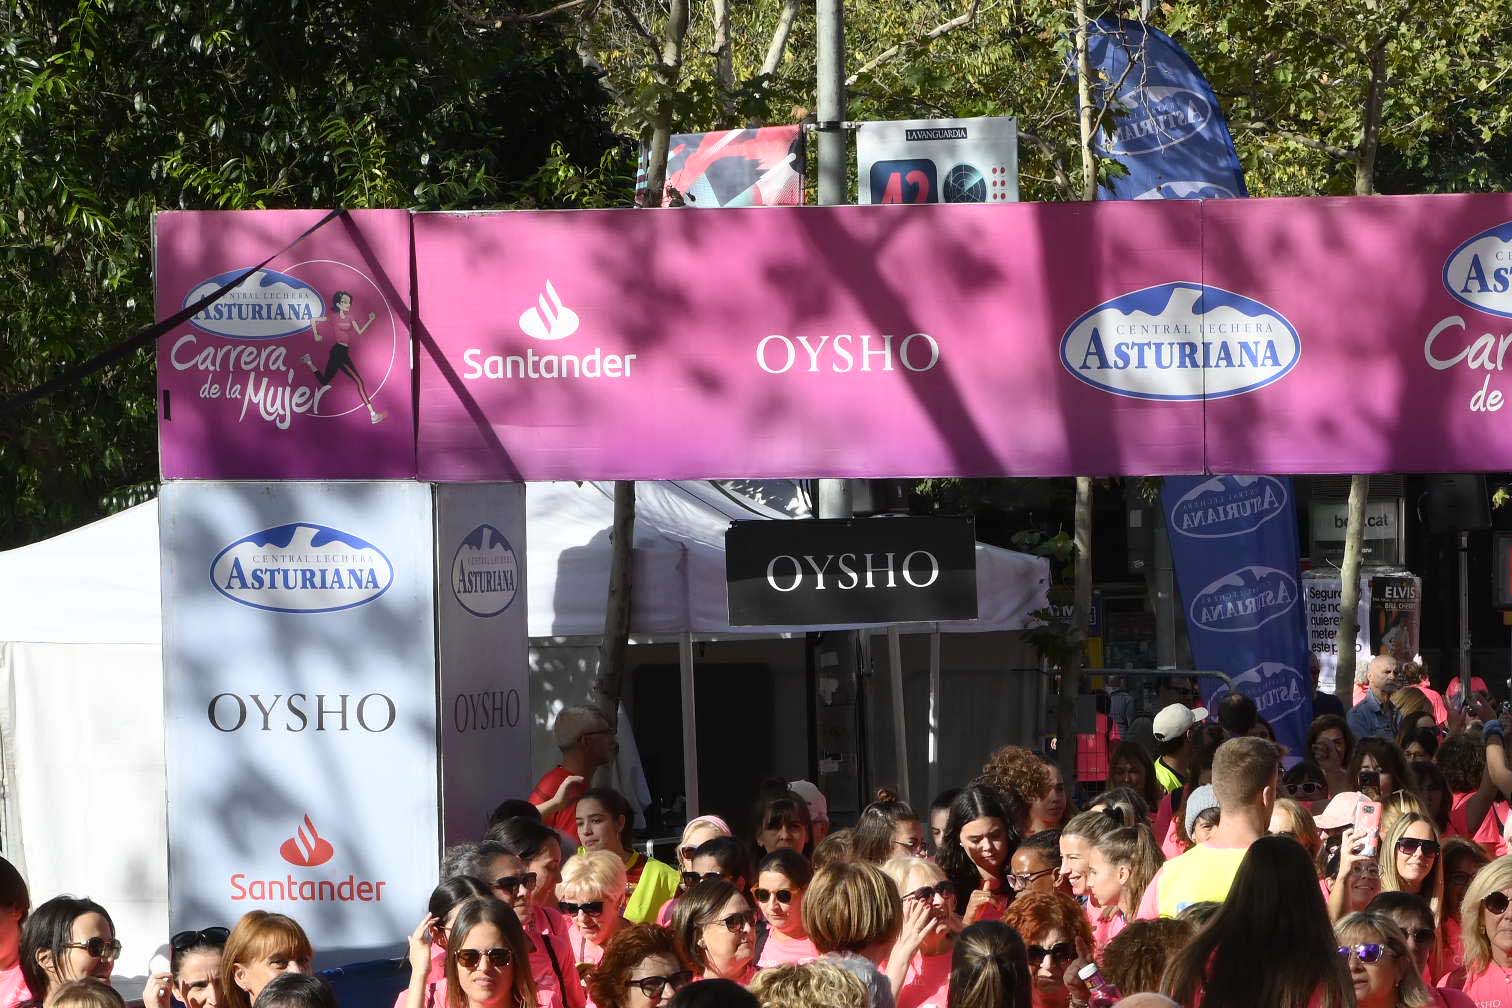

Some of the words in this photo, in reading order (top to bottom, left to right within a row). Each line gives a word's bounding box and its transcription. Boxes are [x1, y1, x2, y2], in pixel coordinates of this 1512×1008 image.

[195, 294, 314, 321] ASTURIANA
[1115, 322, 1194, 336] CENTRAL
[1198, 322, 1274, 335] LECHERA
[170, 334, 288, 372] Carrera
[463, 347, 636, 379] Santander
[756, 333, 940, 374] OYSHO
[1080, 327, 1281, 370] ASTURIANA
[200, 373, 220, 398] de
[226, 374, 241, 398] la
[239, 368, 332, 430] Mujer
[1470, 374, 1503, 411] de
[224, 556, 380, 590] ASTURIANA
[252, 553, 308, 563] CENTRAL
[315, 554, 374, 563] LECHERA
[766, 550, 939, 592] OYSHO
[457, 566, 516, 595] ASTURIANA
[1385, 585, 1416, 599] ELVIS
[1311, 603, 1327, 614] que
[1311, 616, 1342, 627] quiere
[1312, 641, 1331, 652] este
[207, 692, 396, 733] OYSHO
[454, 688, 520, 733] OYSHO
[230, 873, 386, 902] Santander
[1475, 1000, 1501, 1008] YSHO
